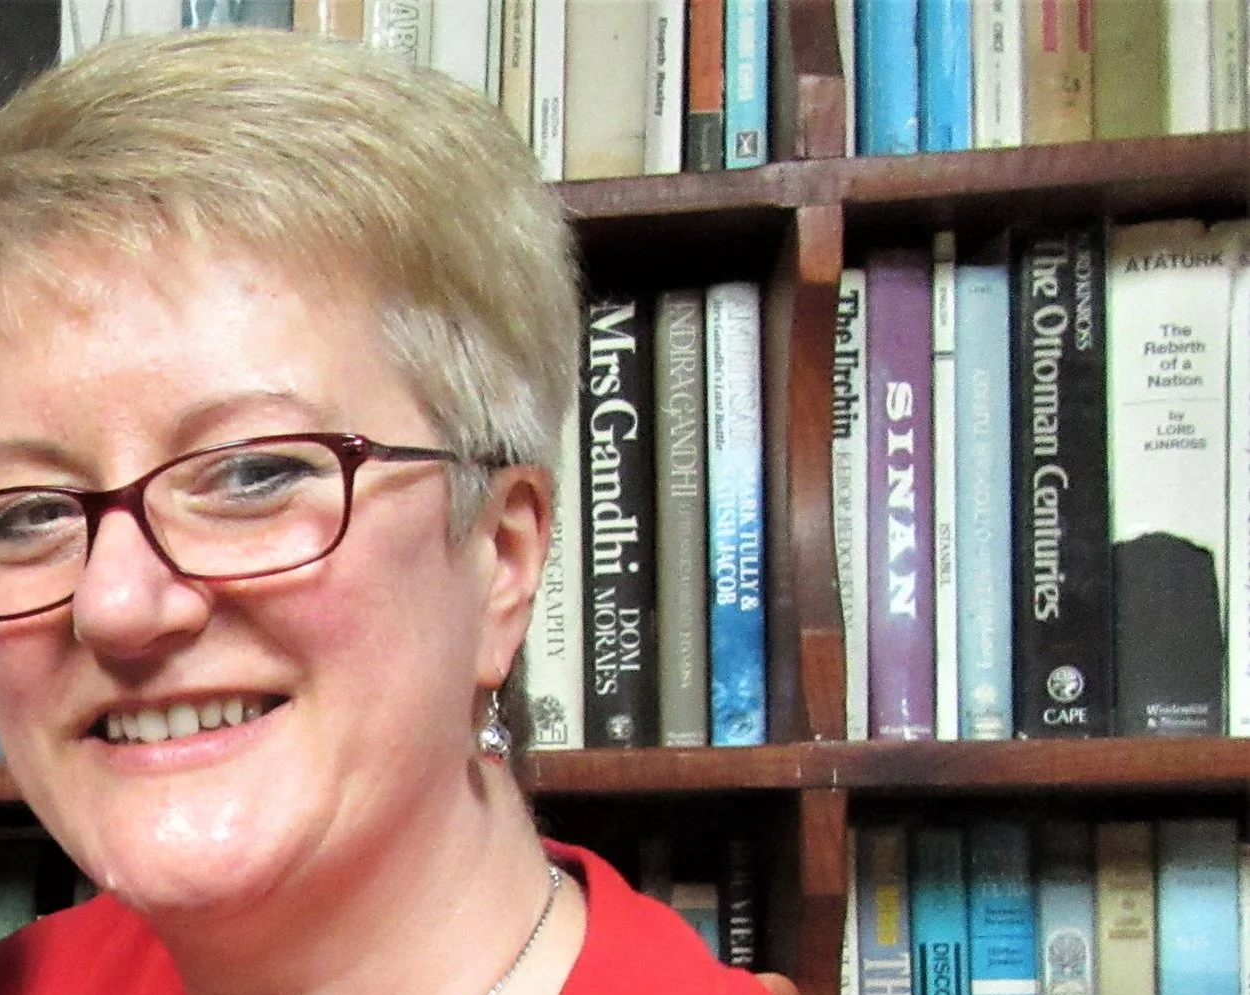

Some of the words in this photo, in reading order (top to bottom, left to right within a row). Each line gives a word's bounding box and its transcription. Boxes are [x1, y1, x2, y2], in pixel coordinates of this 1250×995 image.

[655, 17, 668, 67] Elspeth
[1031, 244, 1070, 297] The
[834, 289, 859, 344] The
[1075, 280, 1093, 351] KINROSS
[1160, 323, 1192, 337] The
[588, 304, 636, 396] Mrs
[711, 323, 724, 380] Gandhi's
[1143, 340, 1205, 355] Rebirth
[1160, 356, 1179, 371] of
[1183, 360, 1192, 371] a
[712, 383, 724, 409] Last
[832, 349, 860, 439] Urchin
[1033, 303, 1070, 457] Ottoman
[1148, 373, 1203, 388] Nation
[660, 390, 697, 497] GANDHI
[713, 411, 725, 451] Battle
[1144, 438, 1207, 452] KINROSS
[1156, 424, 1195, 436] LORD
[1168, 410, 1186, 423] by
[590, 399, 640, 576] Gandhi
[714, 465, 735, 536] SATISH
[738, 466, 759, 528] MARK
[886, 380, 917, 619] SINAN
[738, 532, 760, 596] TULLY
[938, 523, 951, 587] ISTANBUL
[1033, 463, 1070, 621] Centuries
[715, 541, 736, 605] JACOB
[740, 597, 760, 610] &
[594, 587, 617, 697] MORAES
[619, 607, 641, 671] DOM
[1043, 708, 1088, 724] CAPE
